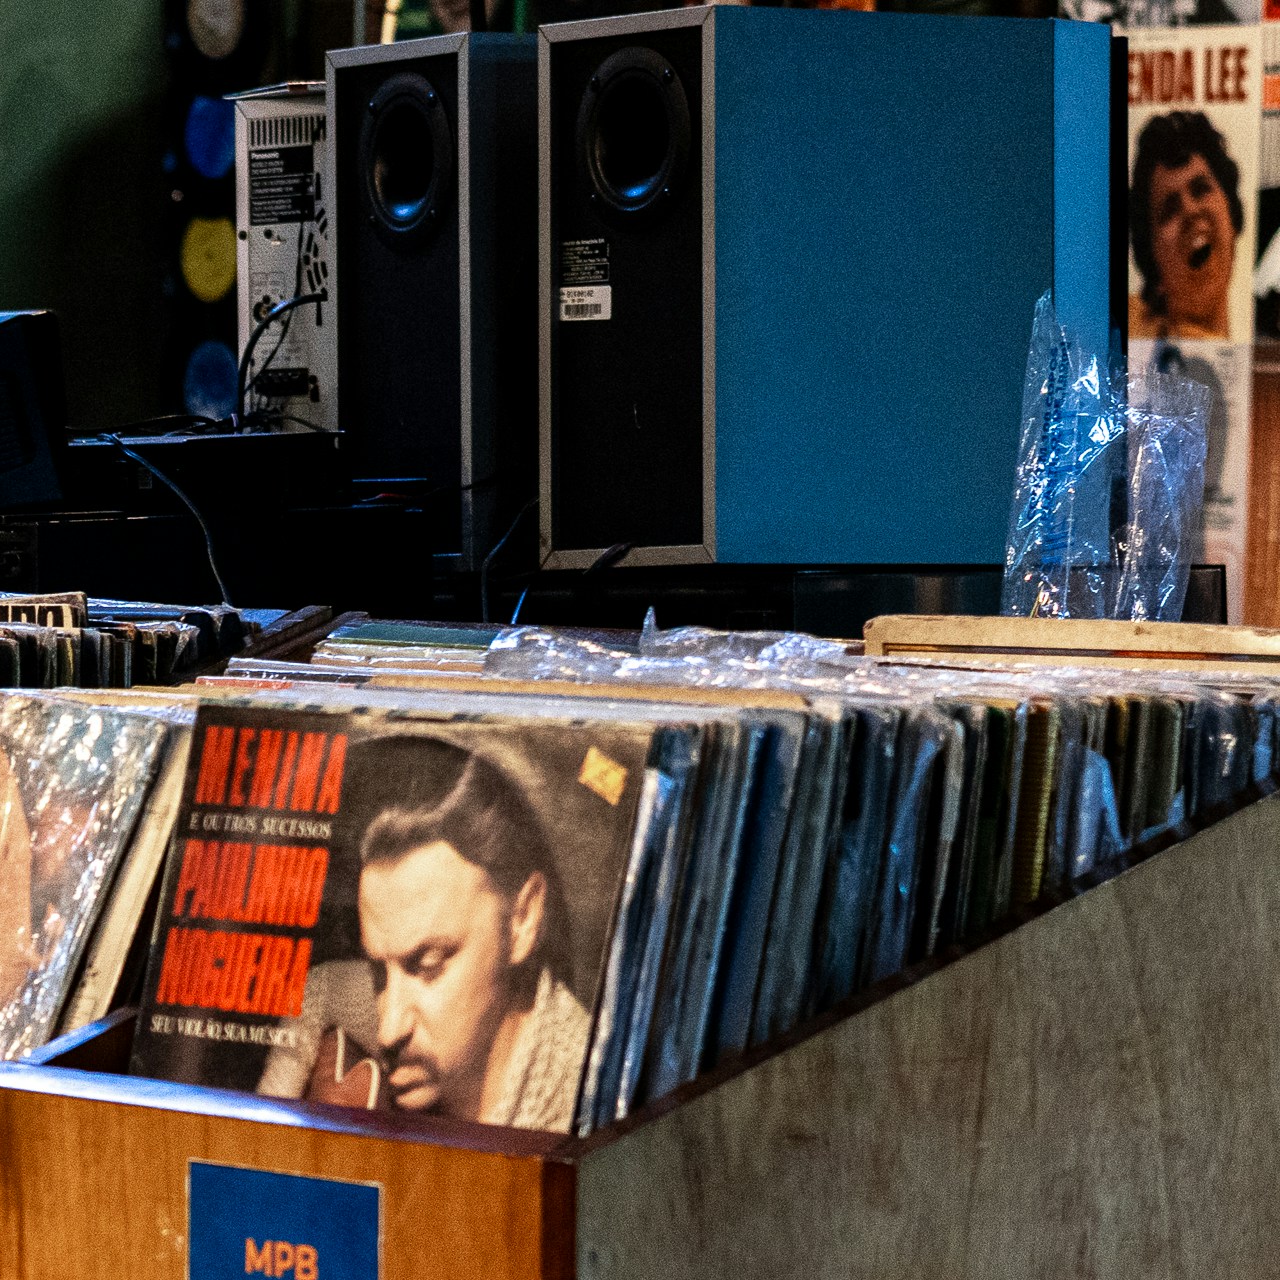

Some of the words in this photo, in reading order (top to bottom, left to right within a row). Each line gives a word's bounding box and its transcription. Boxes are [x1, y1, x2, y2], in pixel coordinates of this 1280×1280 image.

[1205, 46, 1247, 102] LEE
[195, 725, 349, 814] MENINA
[189, 811, 200, 831] E
[203, 813, 258, 833] OUTROS
[261, 817, 332, 839] SUCESSOS
[173, 838, 330, 929] PAULINHO
[156, 927, 313, 1018] NOGUEIRA
